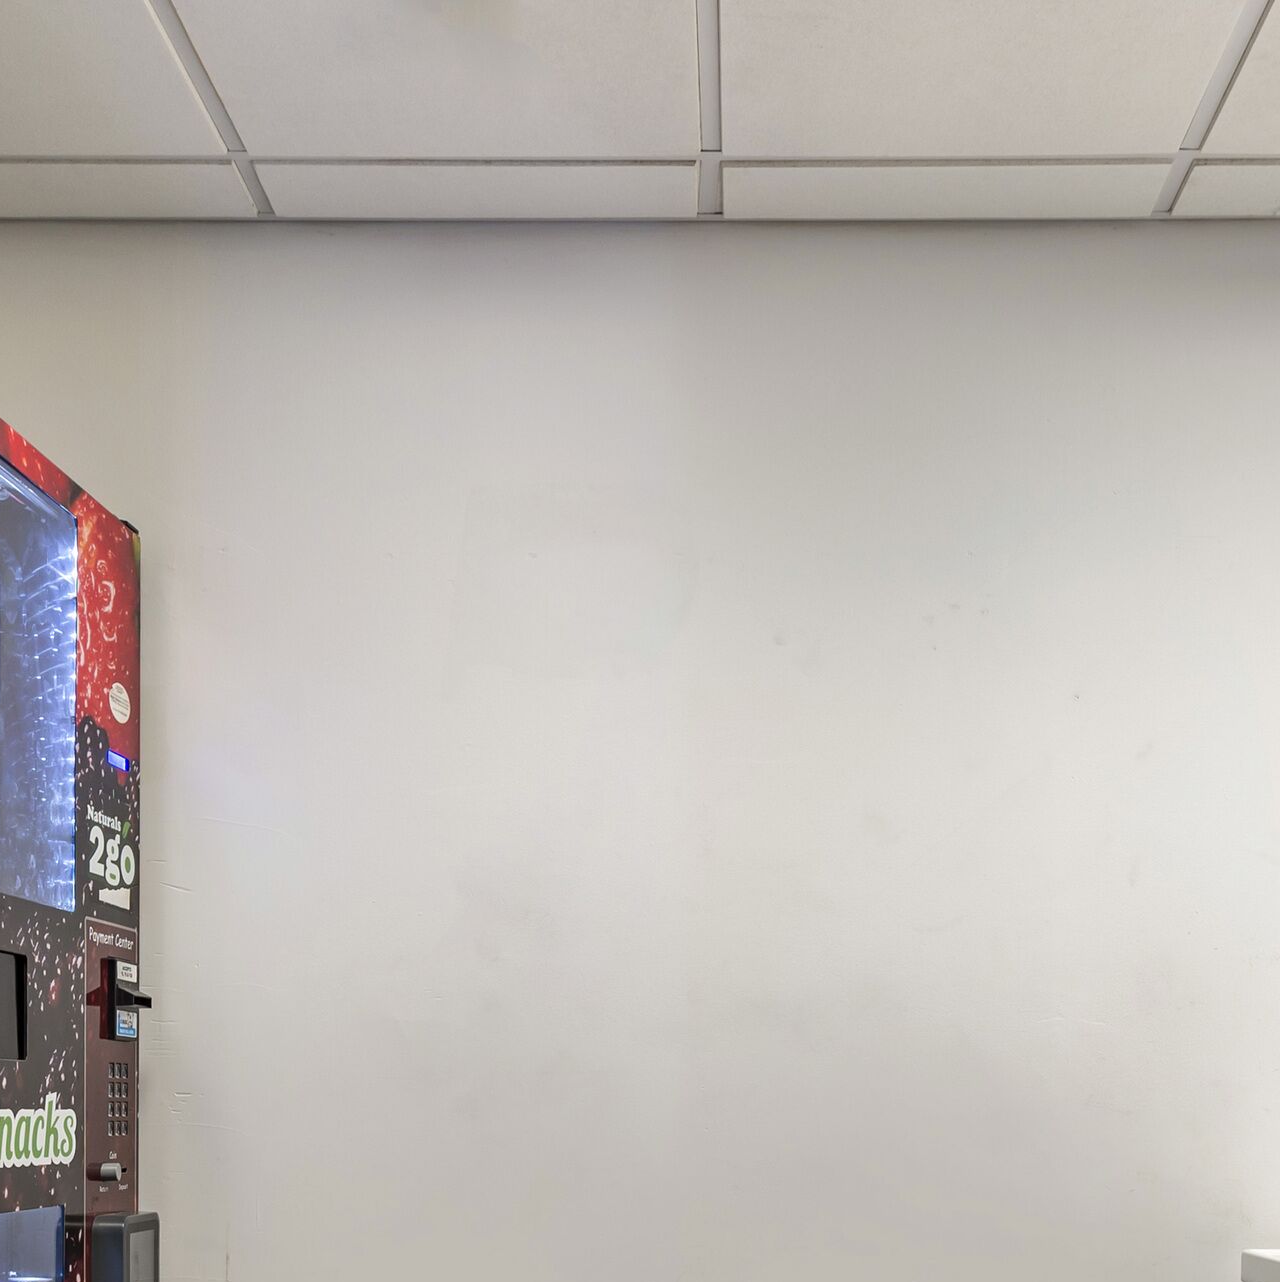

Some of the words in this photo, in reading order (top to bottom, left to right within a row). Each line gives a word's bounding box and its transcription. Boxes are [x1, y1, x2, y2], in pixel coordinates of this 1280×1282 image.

[86, 804, 122, 832] Naturals
[89, 825, 135, 886] 2go
[88, 926, 114, 946] Payment
[115, 933, 134, 950] Center
